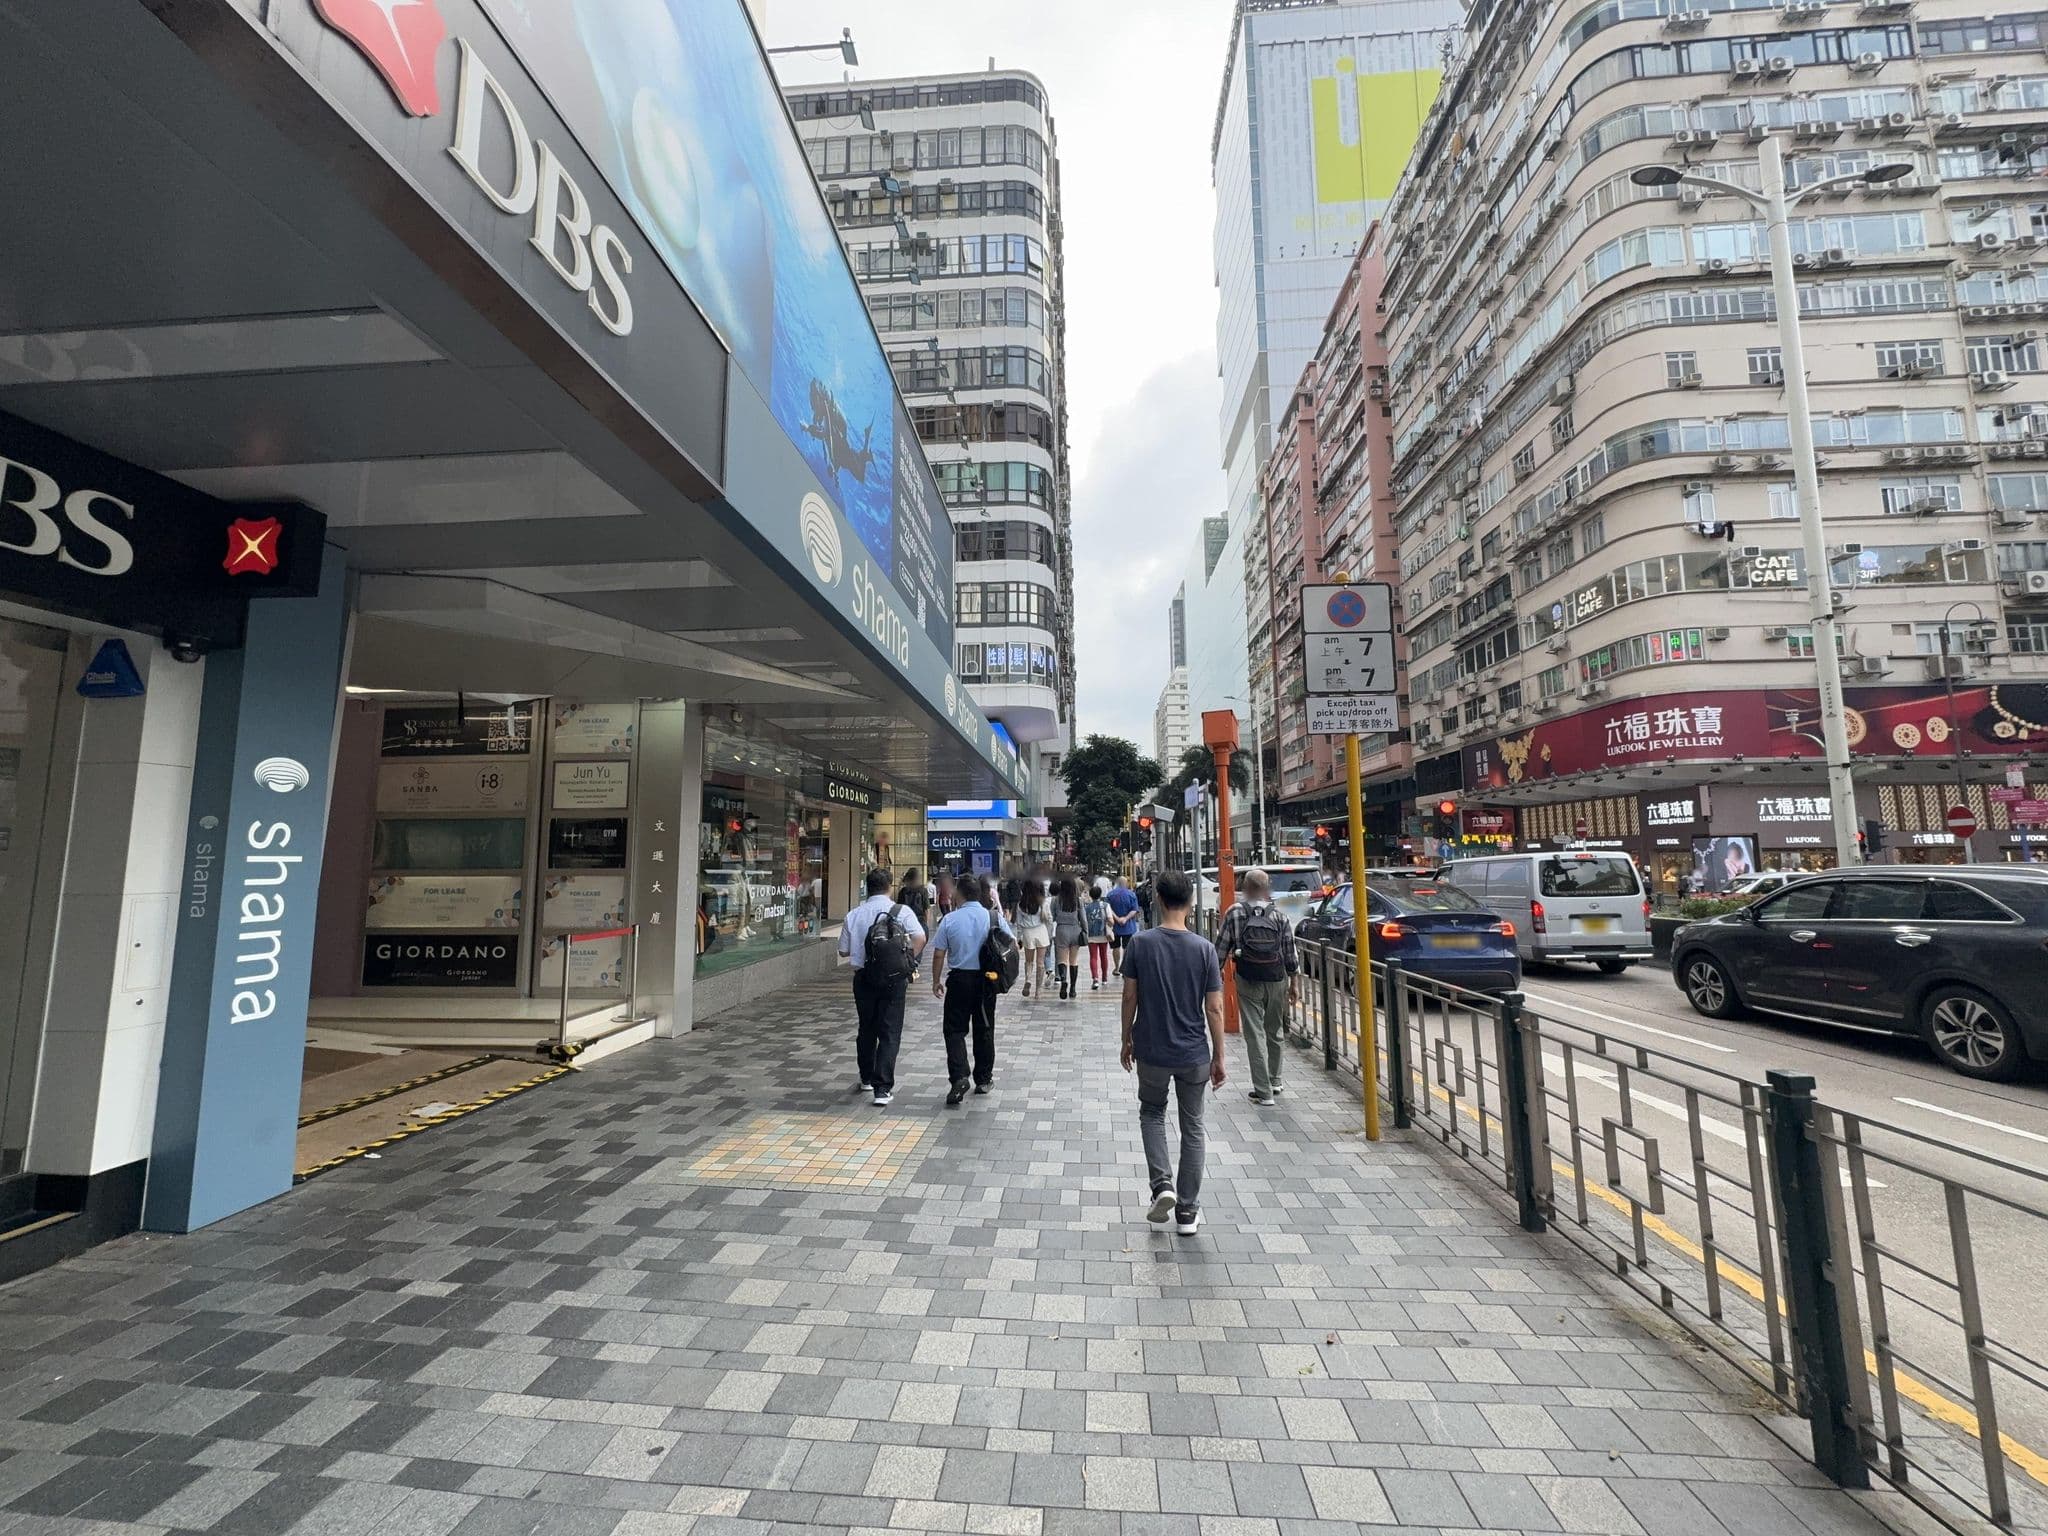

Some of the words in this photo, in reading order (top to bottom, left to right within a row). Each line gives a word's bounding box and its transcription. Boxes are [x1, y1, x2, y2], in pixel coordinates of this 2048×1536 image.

[447, 38, 634, 338] DBS
[1755, 556, 1790, 569] CAT
[1579, 586, 1597, 605] CAT
[852, 560, 909, 669] shama
[1320, 647, 1345, 657] 上午
[1359, 637, 1373, 656] 7
[1326, 668, 1342, 676] pm
[1361, 668, 1375, 687] 7
[1322, 678, 1347, 688] 下午
[1327, 699, 1358, 709] Except
[1360, 699, 1376, 707] taxi
[1316, 709, 1336, 718] pick
[1337, 708, 1373, 719] up/drop
[1374, 707, 1387, 716] off
[1312, 718, 1394, 730] 的士上落客除外
[1604, 706, 1723, 746] 六福珠寶
[1607, 742, 1646, 756] LUKFOOK
[1649, 736, 1724, 751] JEWELLERY
[573, 766, 593, 779] Jun
[596, 766, 610, 778] Yu
[829, 783, 869, 805] GIORDANO
[1647, 800, 1694, 818] 六福珠寶
[1758, 797, 1831, 815] 六福珠寶
[603, 829, 617, 838] GYM
[932, 835, 981, 848] citibank
[1912, 833, 1955, 845] 六福珠寶
[188, 843, 216, 920] shama
[750, 885, 793, 899] GIORDANO
[764, 902, 786, 919] matsui
[231, 820, 303, 1027] shama
[376, 944, 506, 959] GIORDANO
